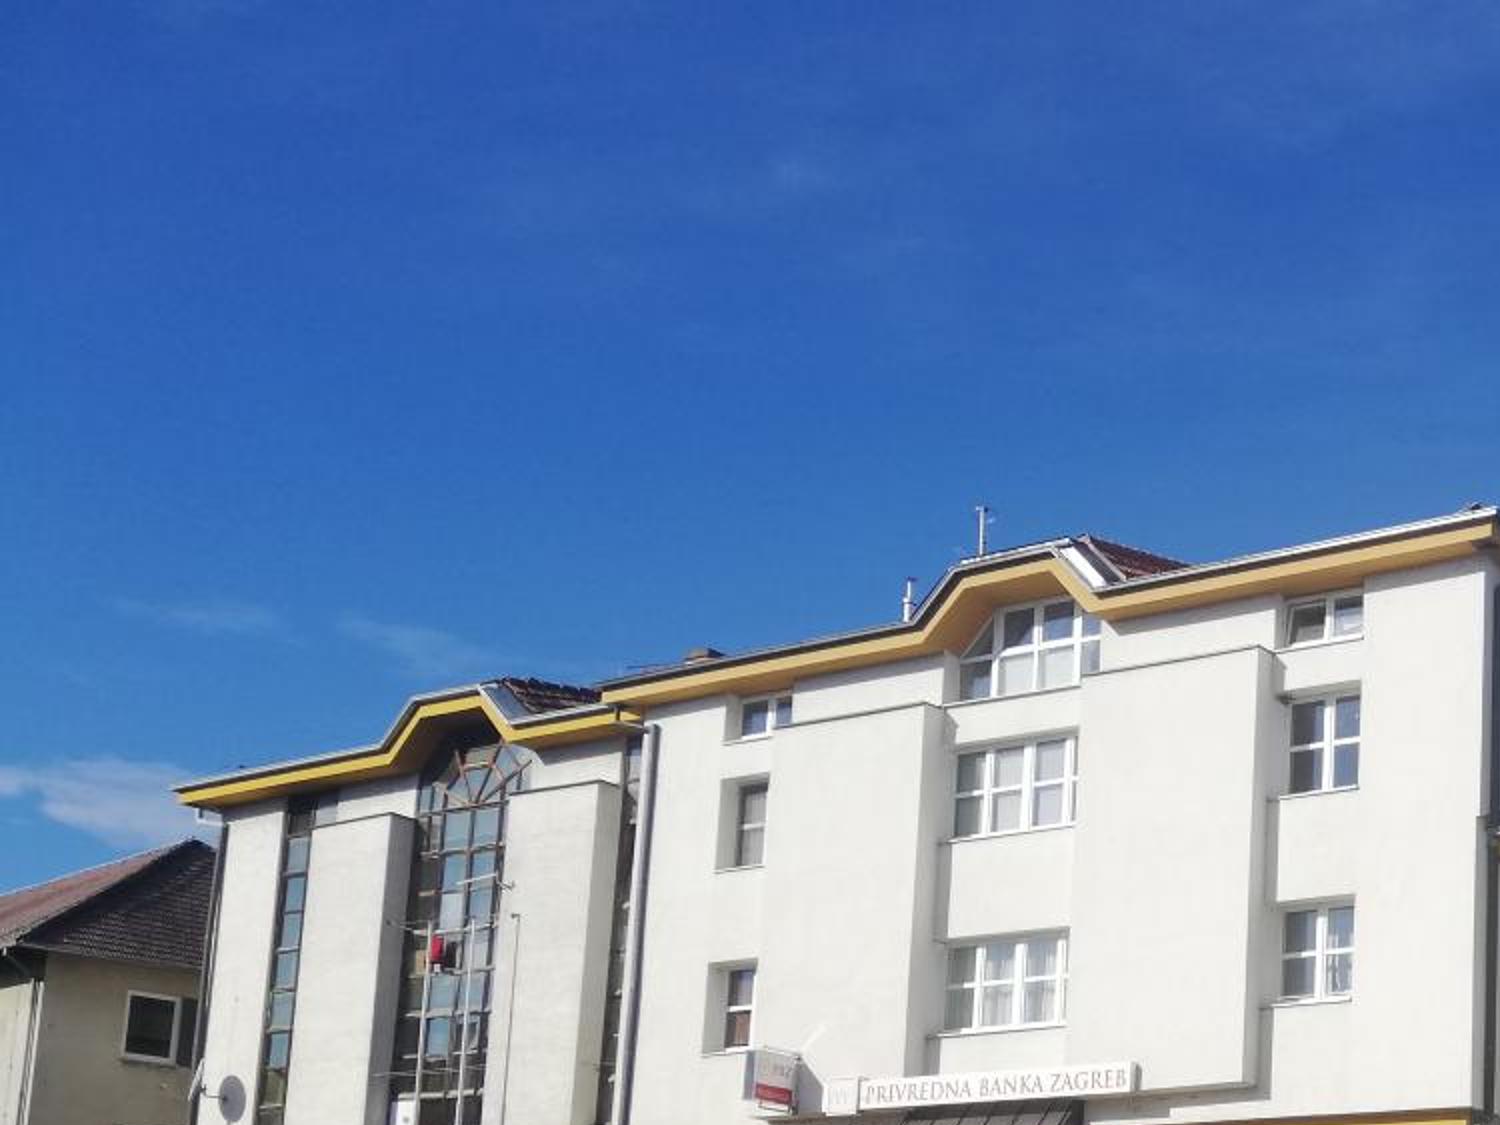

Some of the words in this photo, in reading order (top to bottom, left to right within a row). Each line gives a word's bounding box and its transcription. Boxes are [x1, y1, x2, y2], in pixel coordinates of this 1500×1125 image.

[865, 1080, 972, 1104] PRIVREDNA
[979, 1073, 1044, 1097] BANKA
[1050, 1068, 1127, 1093] ZAGREB
